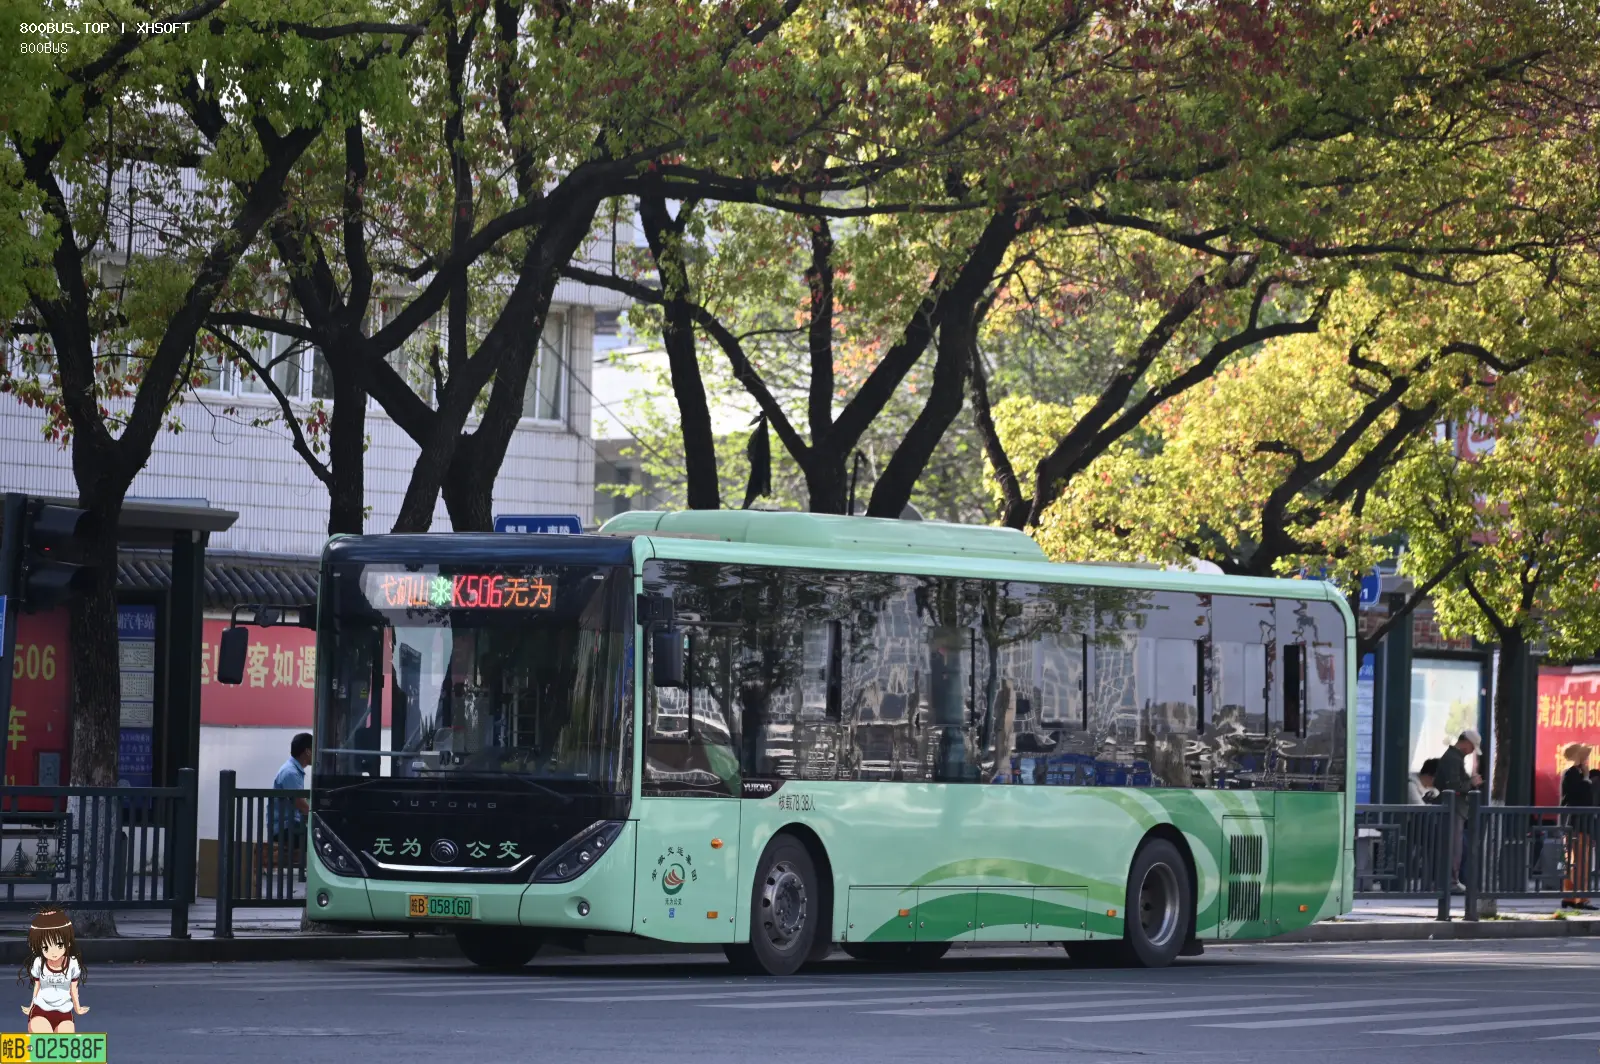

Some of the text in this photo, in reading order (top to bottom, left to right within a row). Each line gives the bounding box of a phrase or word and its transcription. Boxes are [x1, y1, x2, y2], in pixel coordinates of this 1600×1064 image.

[452, 575, 503, 608] K506
[503, 578, 552, 608] 无为
[743, 783, 773, 792] YUTONG
[392, 800, 497, 809] YUTONG
[372, 837, 522, 859] 无为 公交
